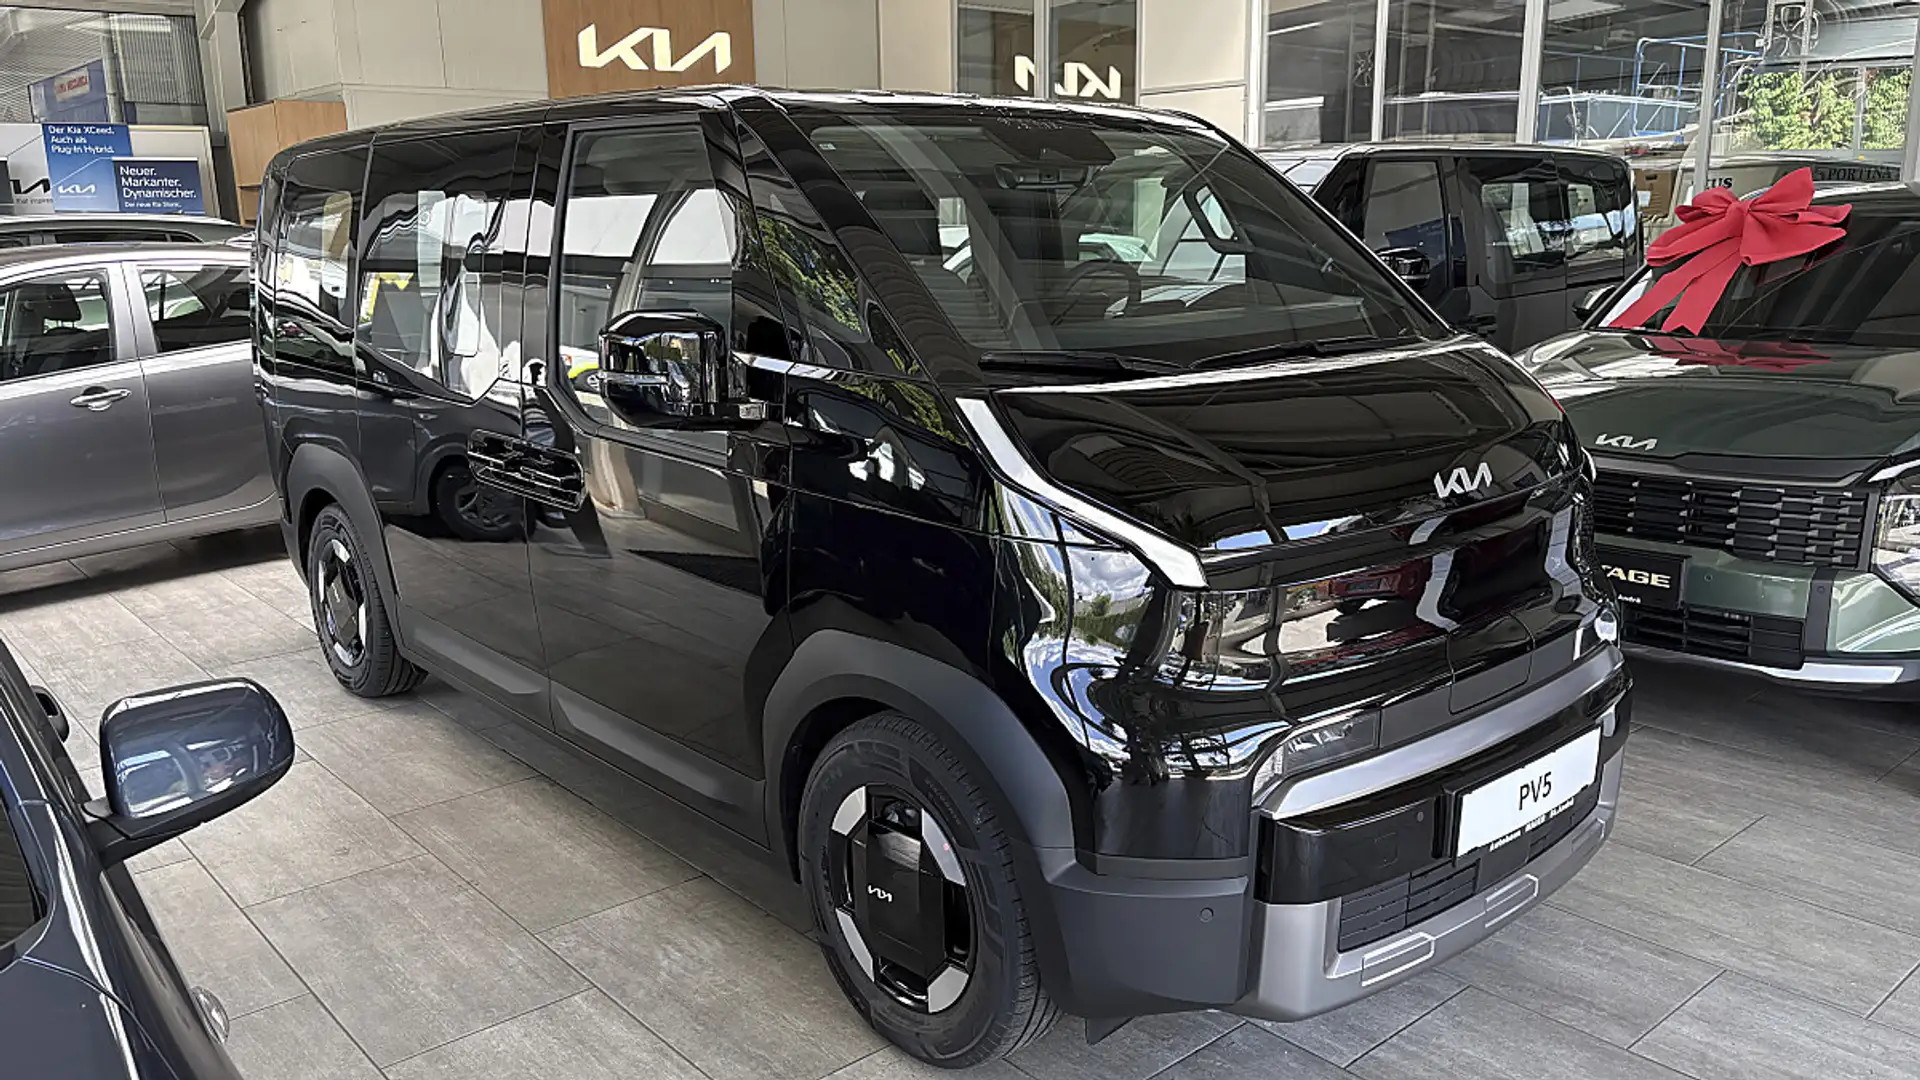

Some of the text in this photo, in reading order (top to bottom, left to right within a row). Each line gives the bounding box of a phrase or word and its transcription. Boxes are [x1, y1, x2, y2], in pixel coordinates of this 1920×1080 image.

[578, 23, 732, 75] KIA
[48, 125, 115, 135] Der Kia XCeed.
[51, 135, 87, 144] Auch als
[84, 145, 115, 155] Hybrid.
[120, 165, 157, 176] Neuer.
[121, 177, 182, 187] Markanter.
[58, 184, 96, 194] KIA
[123, 188, 197, 199] Dynamischer.
[1595, 433, 1657, 451] KIA
[1434, 462, 1492, 498] KIA
[1518, 771, 1552, 811] PV5
